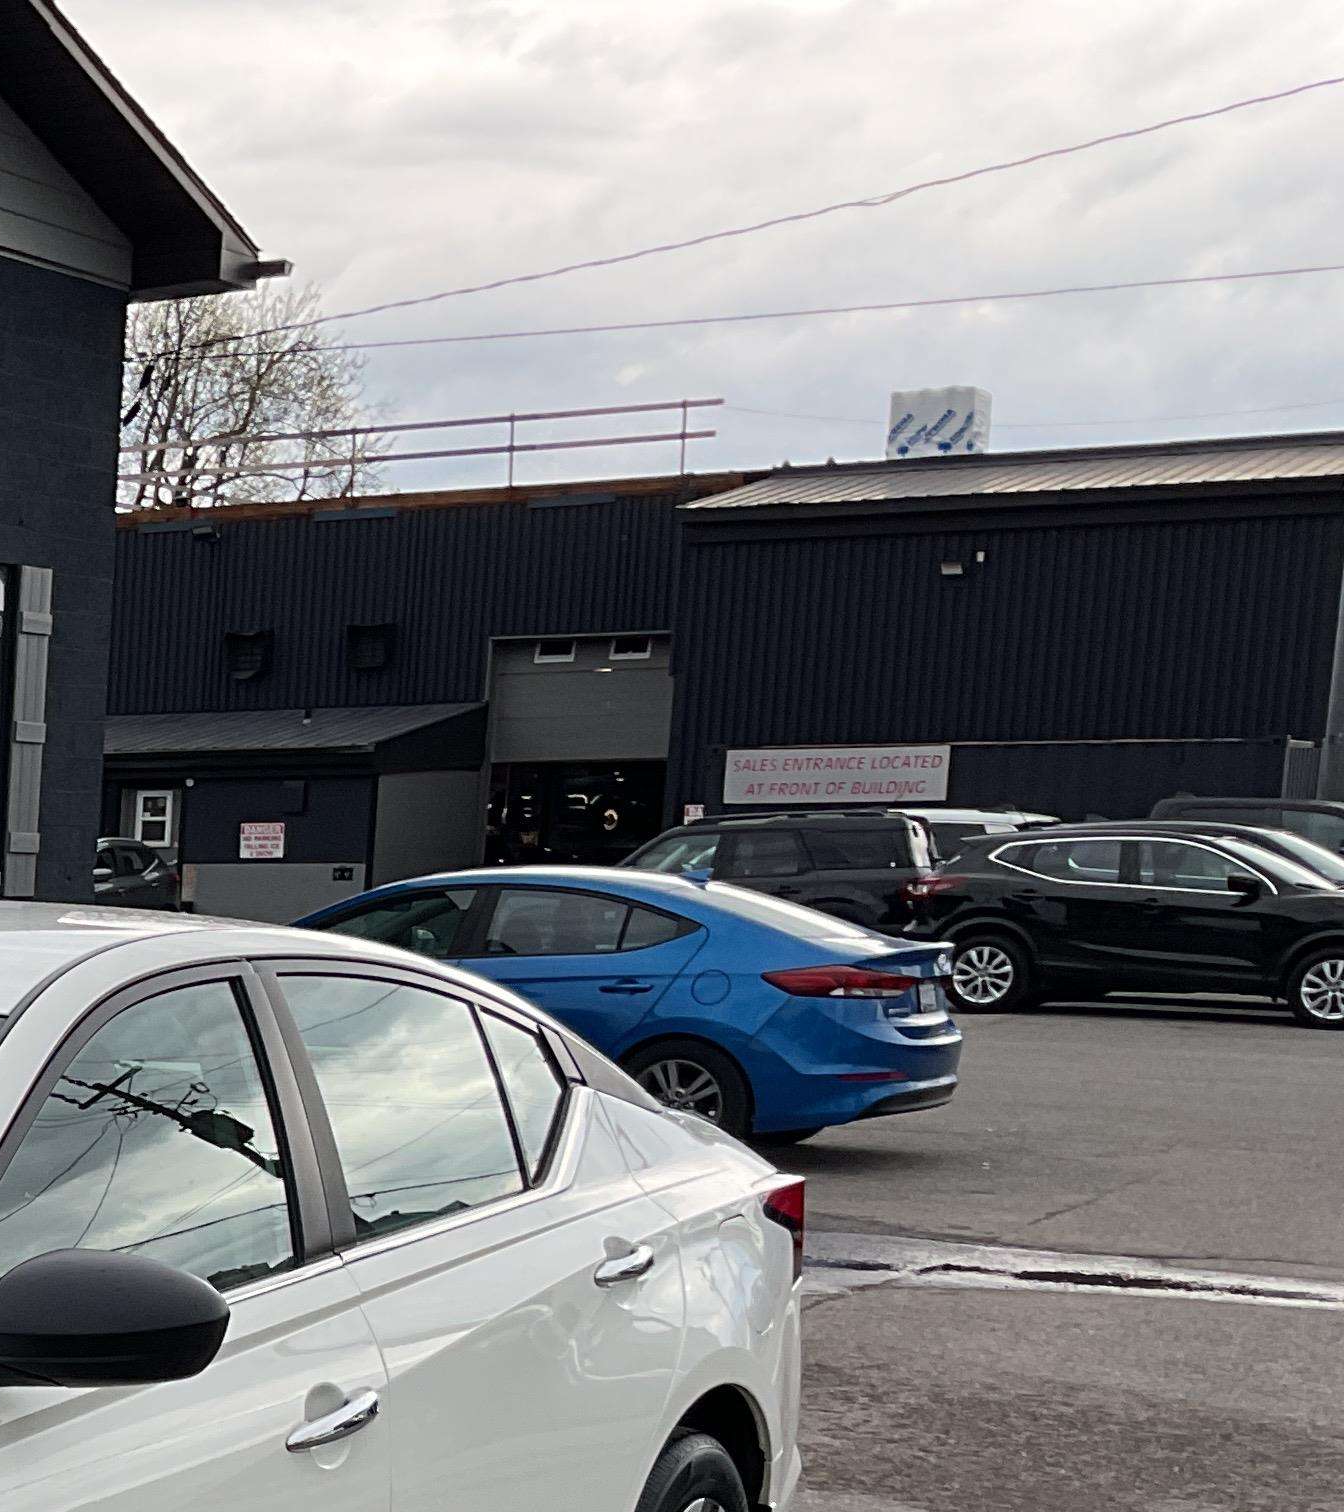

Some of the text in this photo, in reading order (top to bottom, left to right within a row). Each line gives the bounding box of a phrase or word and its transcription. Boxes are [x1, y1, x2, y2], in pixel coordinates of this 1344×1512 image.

[733, 754, 943, 772] SALES ENTRANCE LOCATED
[745, 780, 927, 795] AT FRONT OF BUILDING
